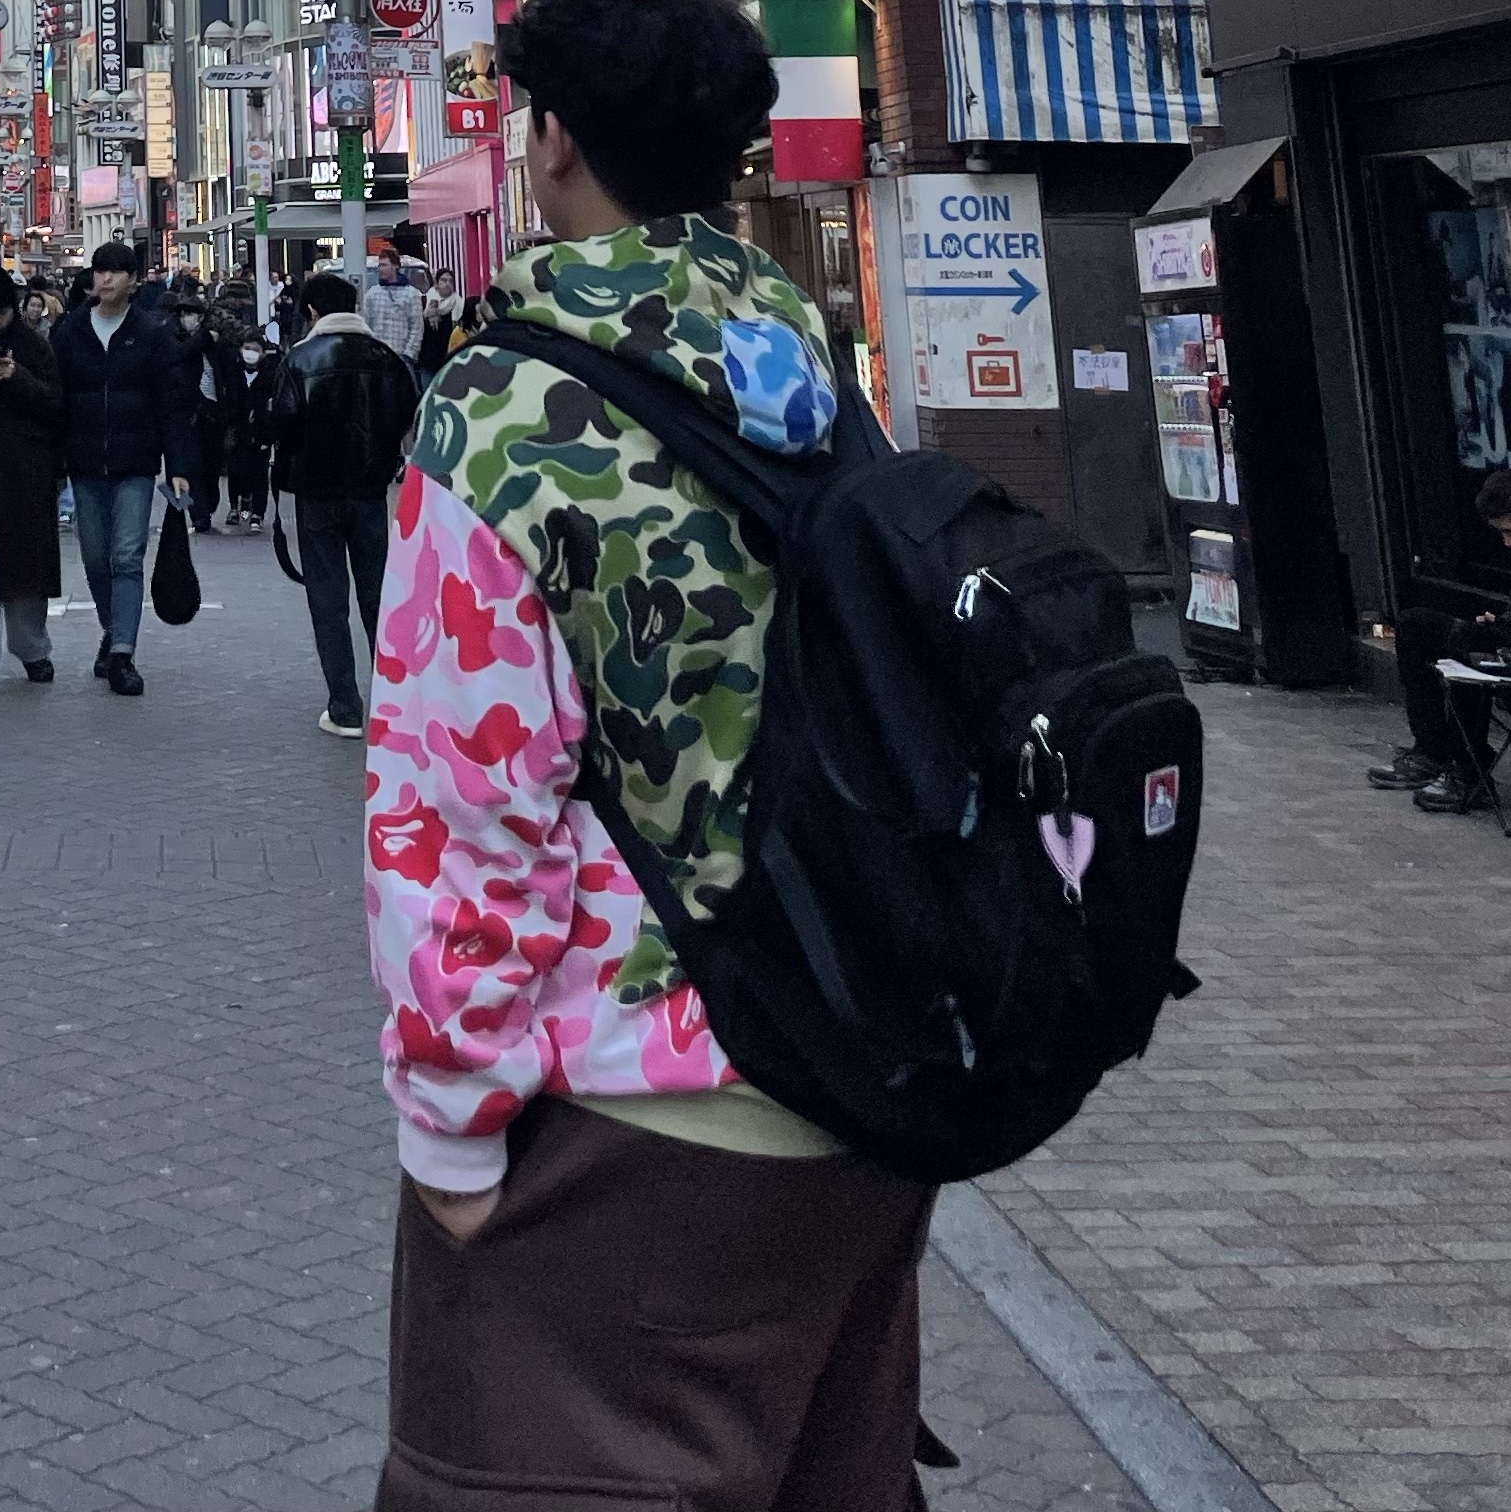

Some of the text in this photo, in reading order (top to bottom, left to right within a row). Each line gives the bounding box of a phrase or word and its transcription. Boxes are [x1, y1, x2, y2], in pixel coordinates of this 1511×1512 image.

[461, 108, 485, 130] B1
[940, 195, 1011, 222] COIN
[924, 233, 1042, 259] LOCKER
